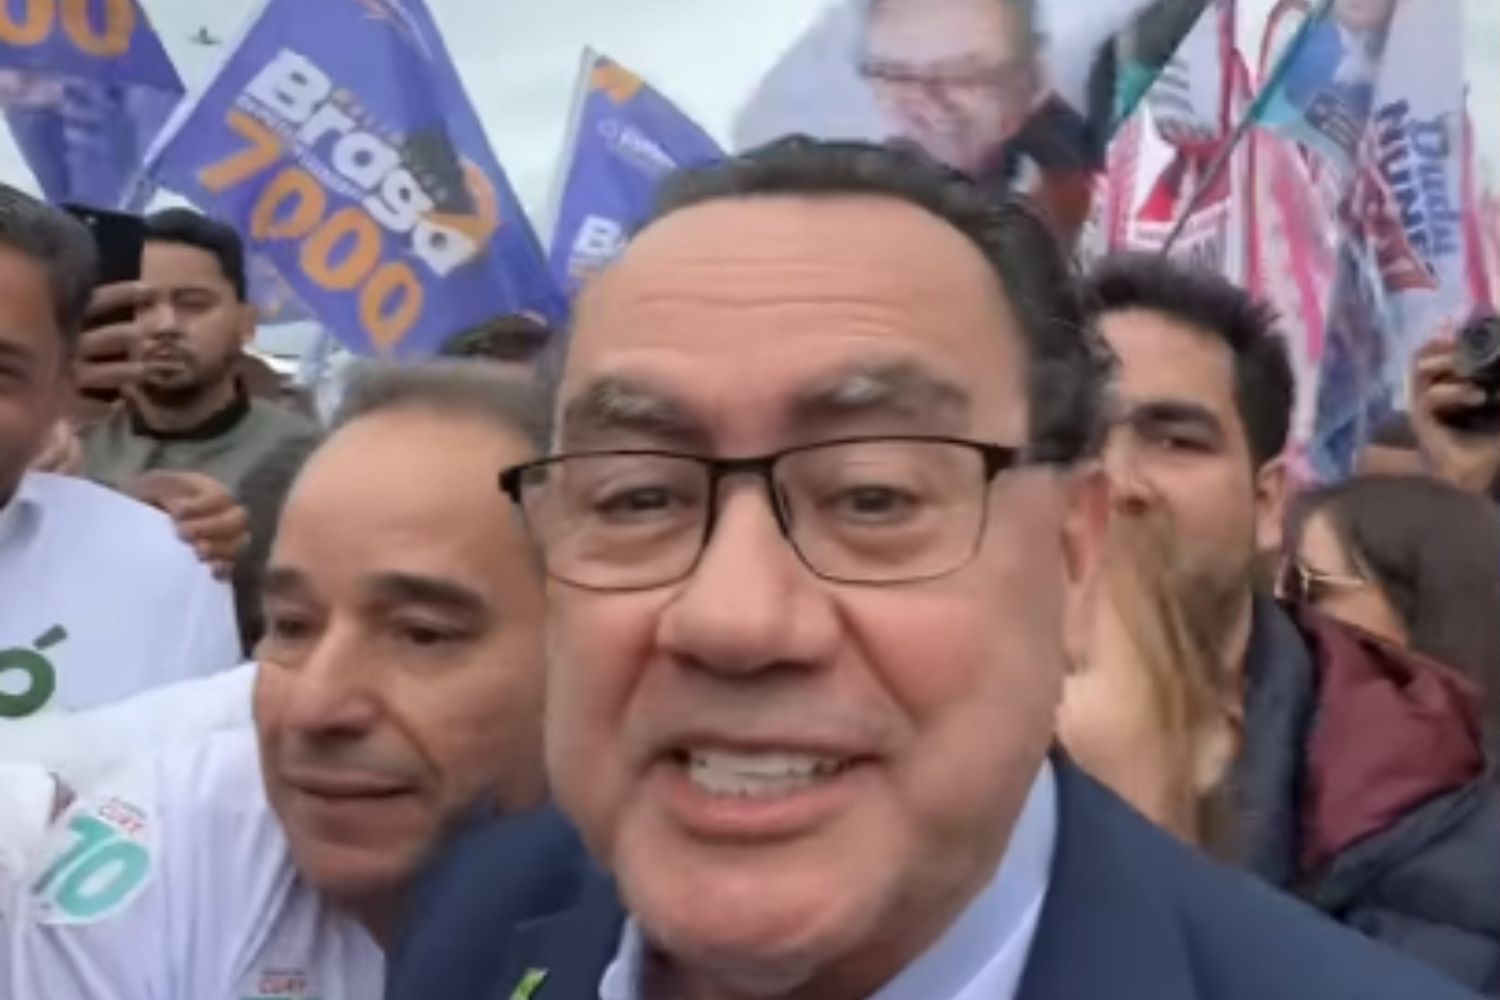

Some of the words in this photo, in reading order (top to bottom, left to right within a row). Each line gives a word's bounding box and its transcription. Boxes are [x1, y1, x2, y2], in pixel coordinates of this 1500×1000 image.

[196, 106, 424, 354] 7000
[238, 47, 477, 277] Braga
[32, 815, 149, 917] 70
